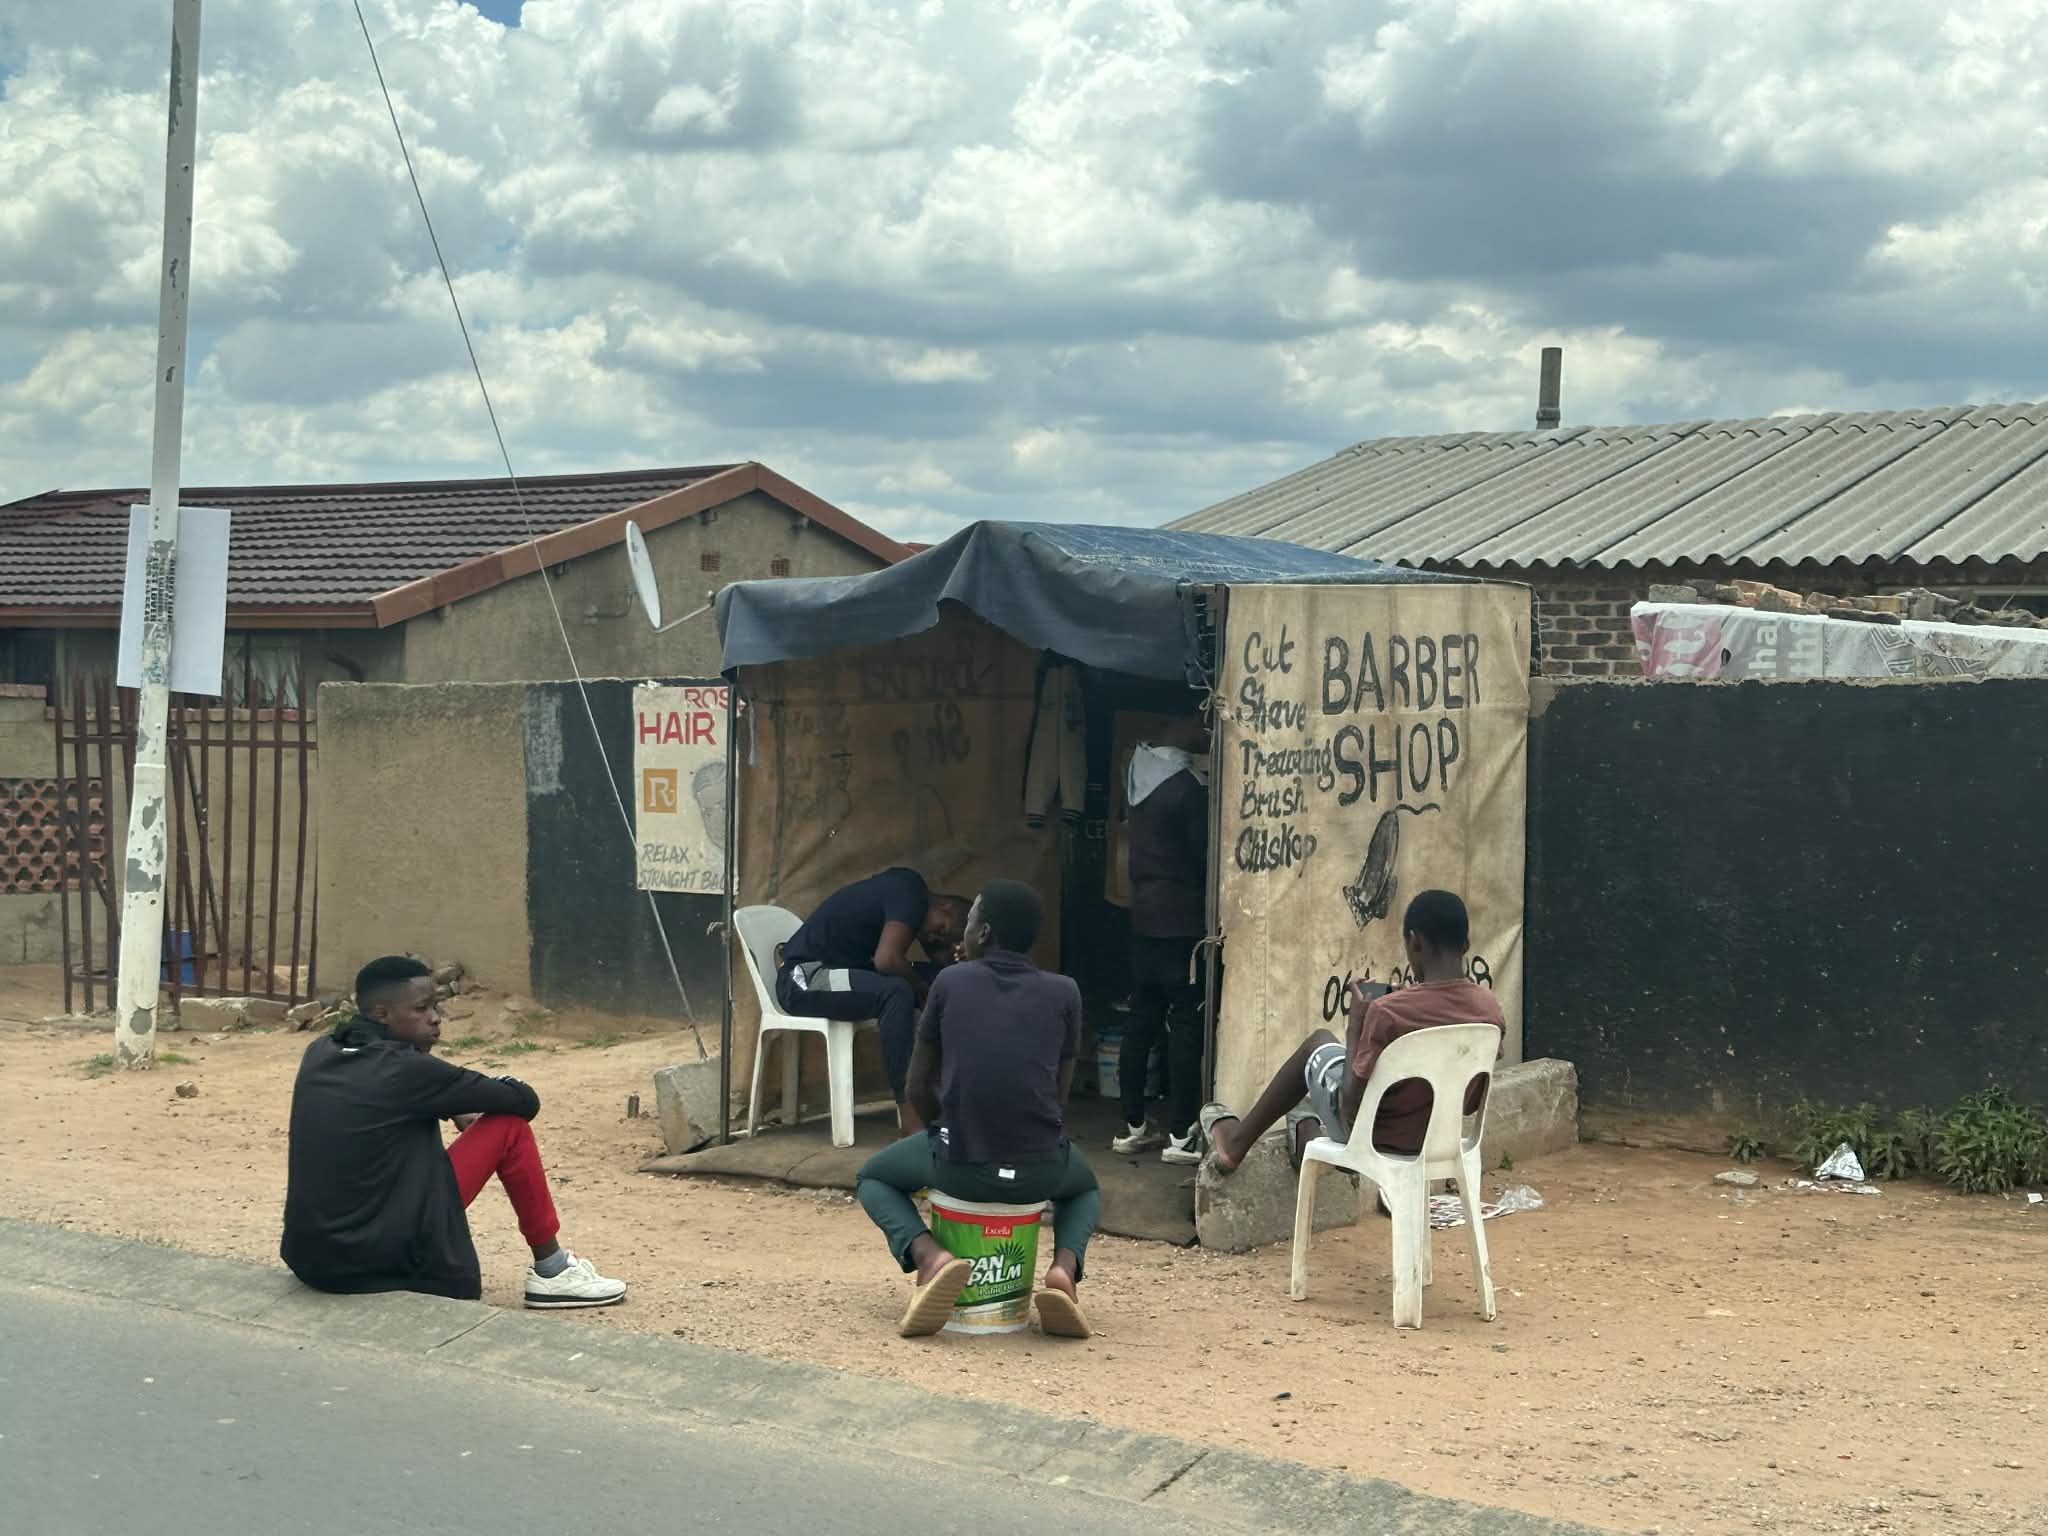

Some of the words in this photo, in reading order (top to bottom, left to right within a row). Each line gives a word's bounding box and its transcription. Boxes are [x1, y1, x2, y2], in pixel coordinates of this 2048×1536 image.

[1244, 624, 1294, 673] Cut
[1322, 632, 1480, 714] BARBER
[685, 688, 730, 710] ROS
[639, 711, 717, 746] HAIR
[1333, 717, 1459, 807] SHOP
[642, 843, 690, 865] RELAX
[967, 1263, 1022, 1286] PALM
